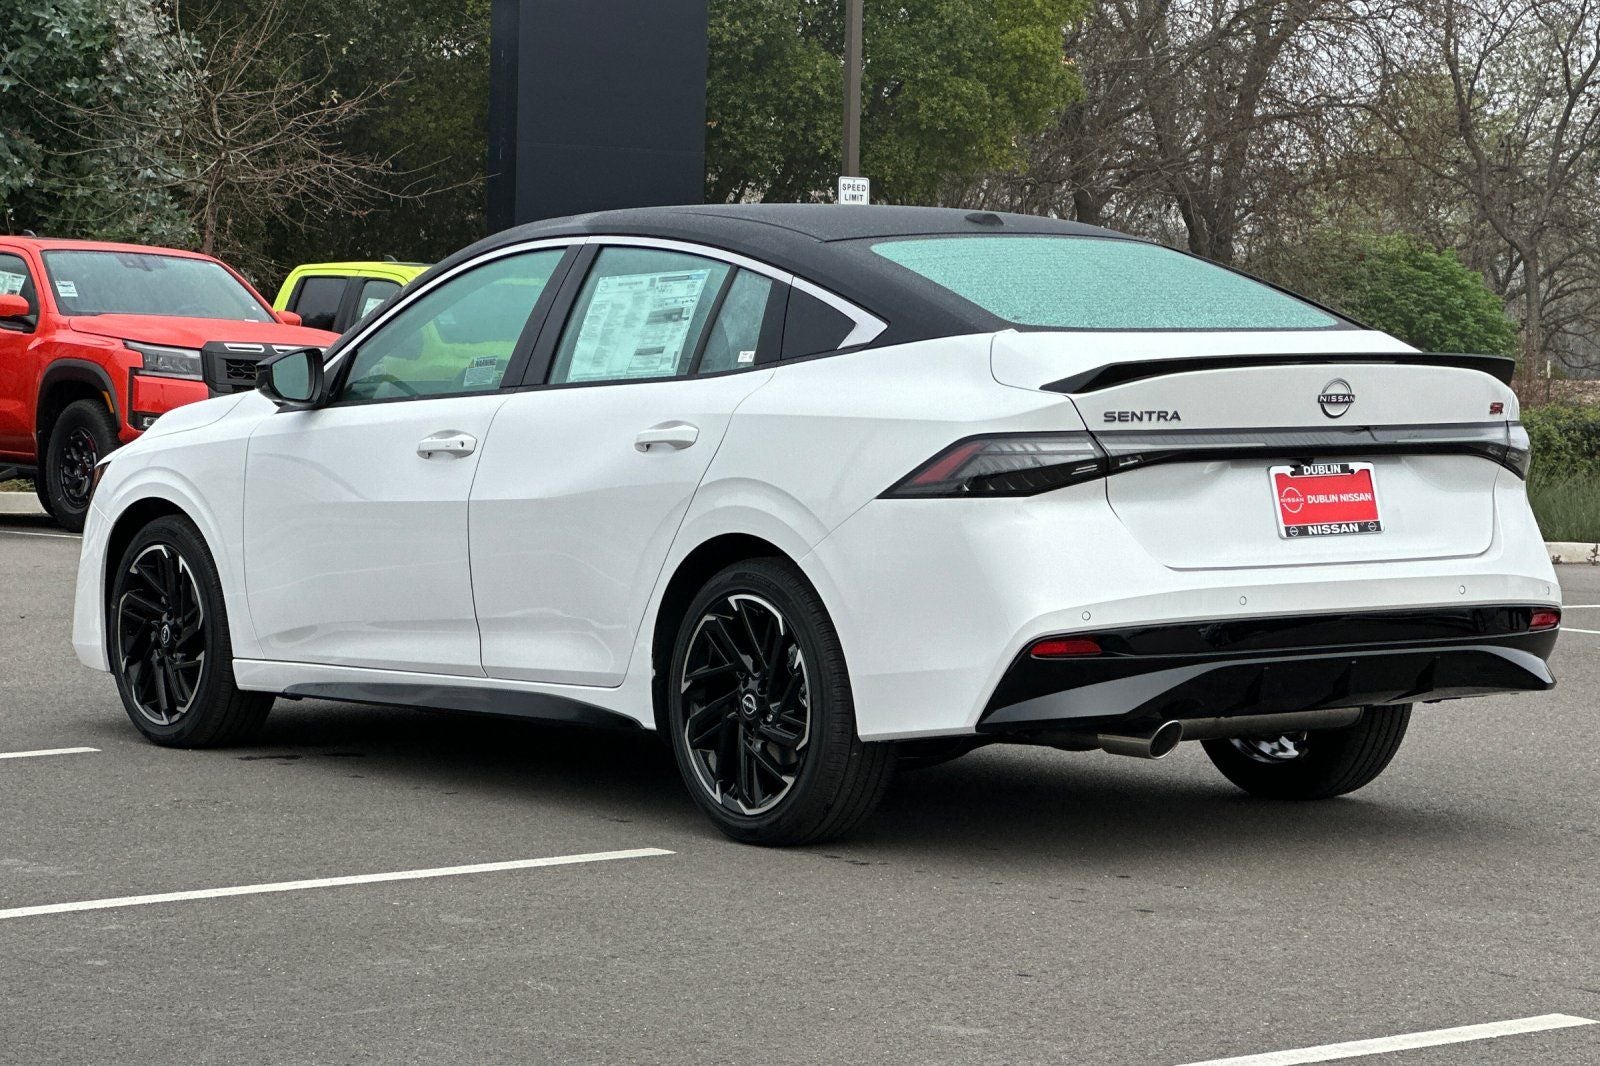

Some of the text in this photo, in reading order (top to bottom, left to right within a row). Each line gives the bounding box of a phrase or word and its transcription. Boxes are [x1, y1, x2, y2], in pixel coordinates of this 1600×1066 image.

[1104, 410, 1182, 422] SENTRA
[1303, 464, 1341, 475] DUBLIN
[1307, 492, 1372, 504] DUBLIN NISSAN
[1308, 523, 1358, 535] NISSAN
